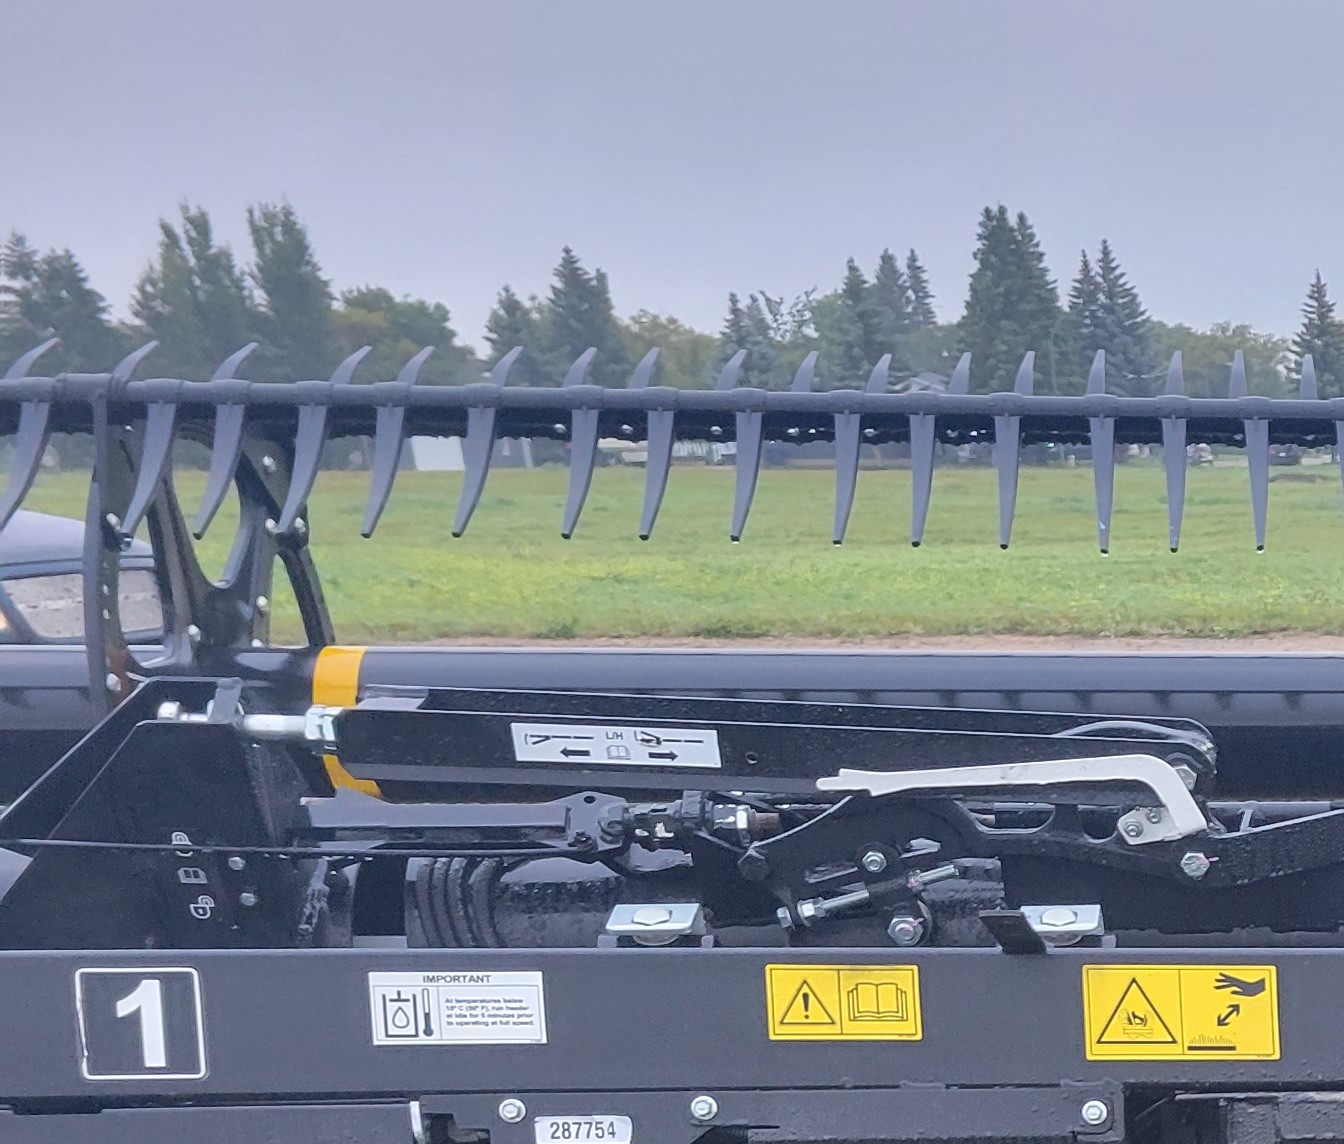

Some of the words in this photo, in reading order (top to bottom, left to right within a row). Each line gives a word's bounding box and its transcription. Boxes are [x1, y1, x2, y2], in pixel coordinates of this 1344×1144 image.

[422, 975, 493, 983] IMPORTANT
[115, 979, 167, 1068] 1
[549, 1120, 617, 1140] 287754
